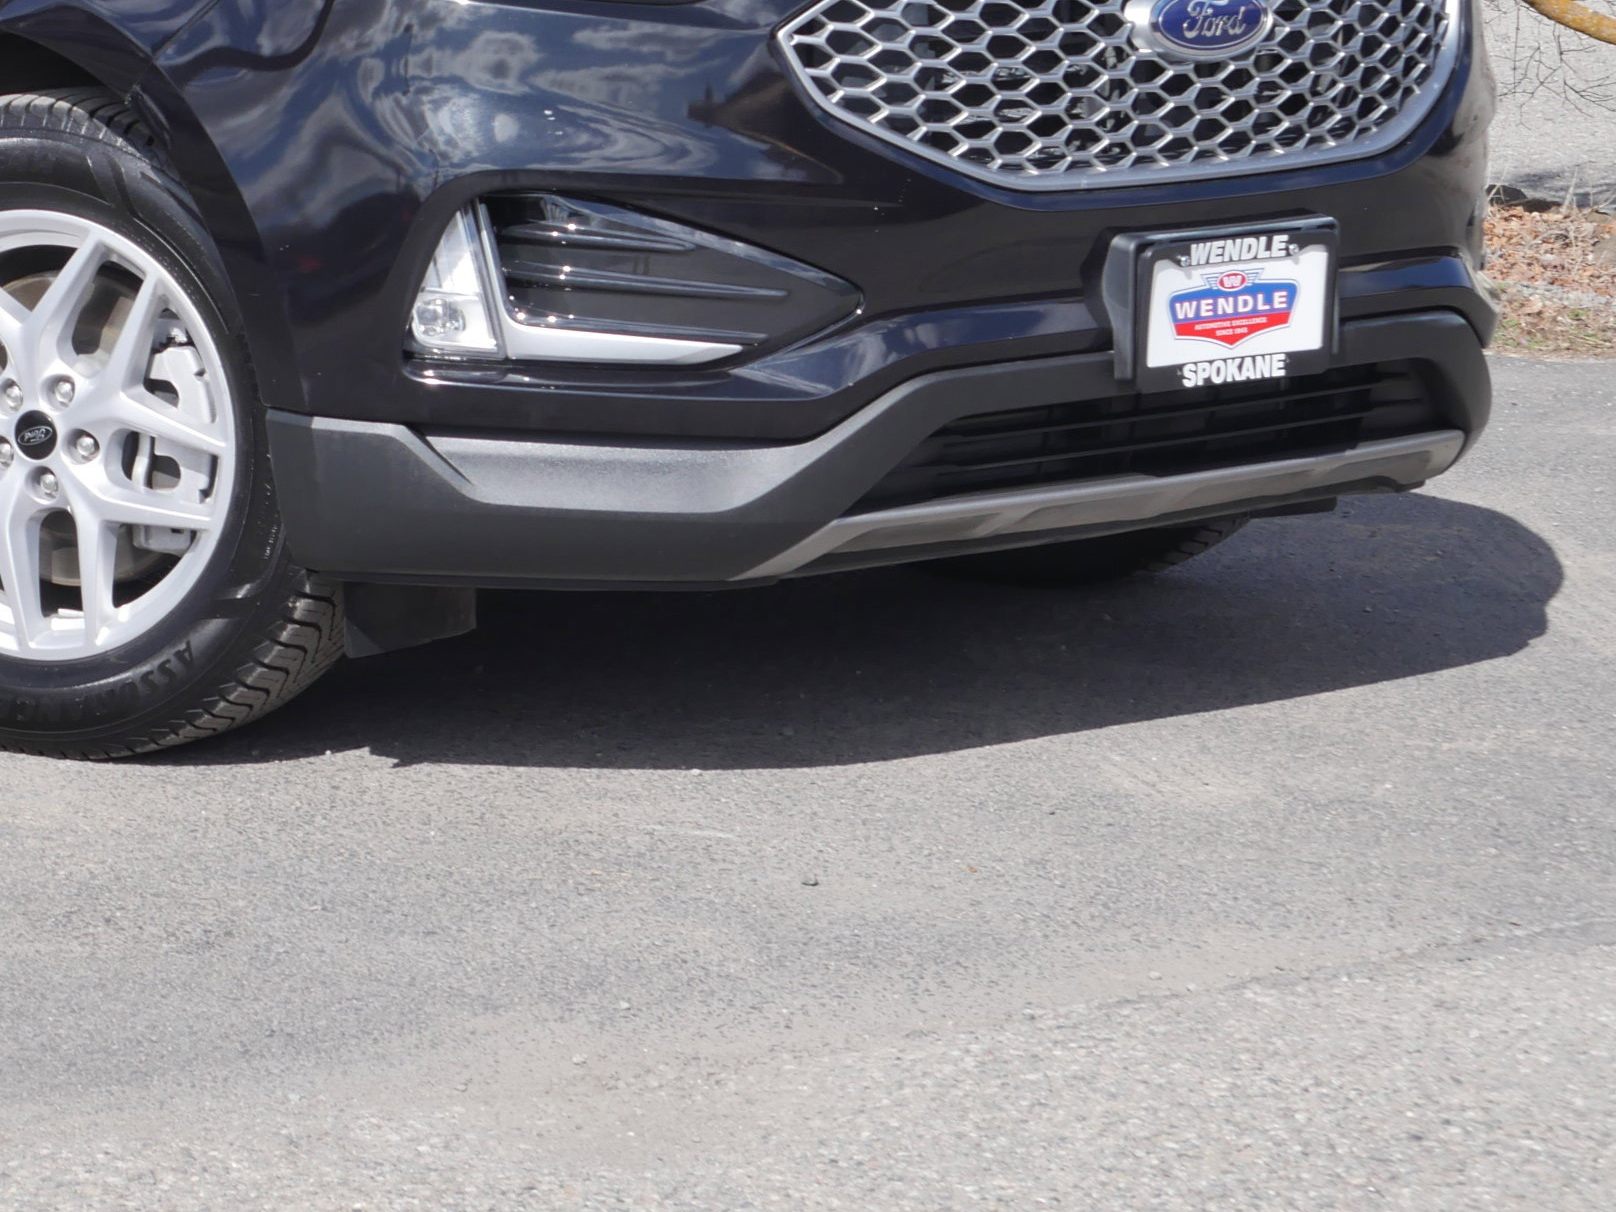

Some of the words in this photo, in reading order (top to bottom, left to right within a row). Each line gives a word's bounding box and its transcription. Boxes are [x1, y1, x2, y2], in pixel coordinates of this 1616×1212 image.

[1190, 235, 1289, 265] WENDLE
[1175, 291, 1288, 319] WENDLE
[1182, 354, 1286, 387] SPOKANE
